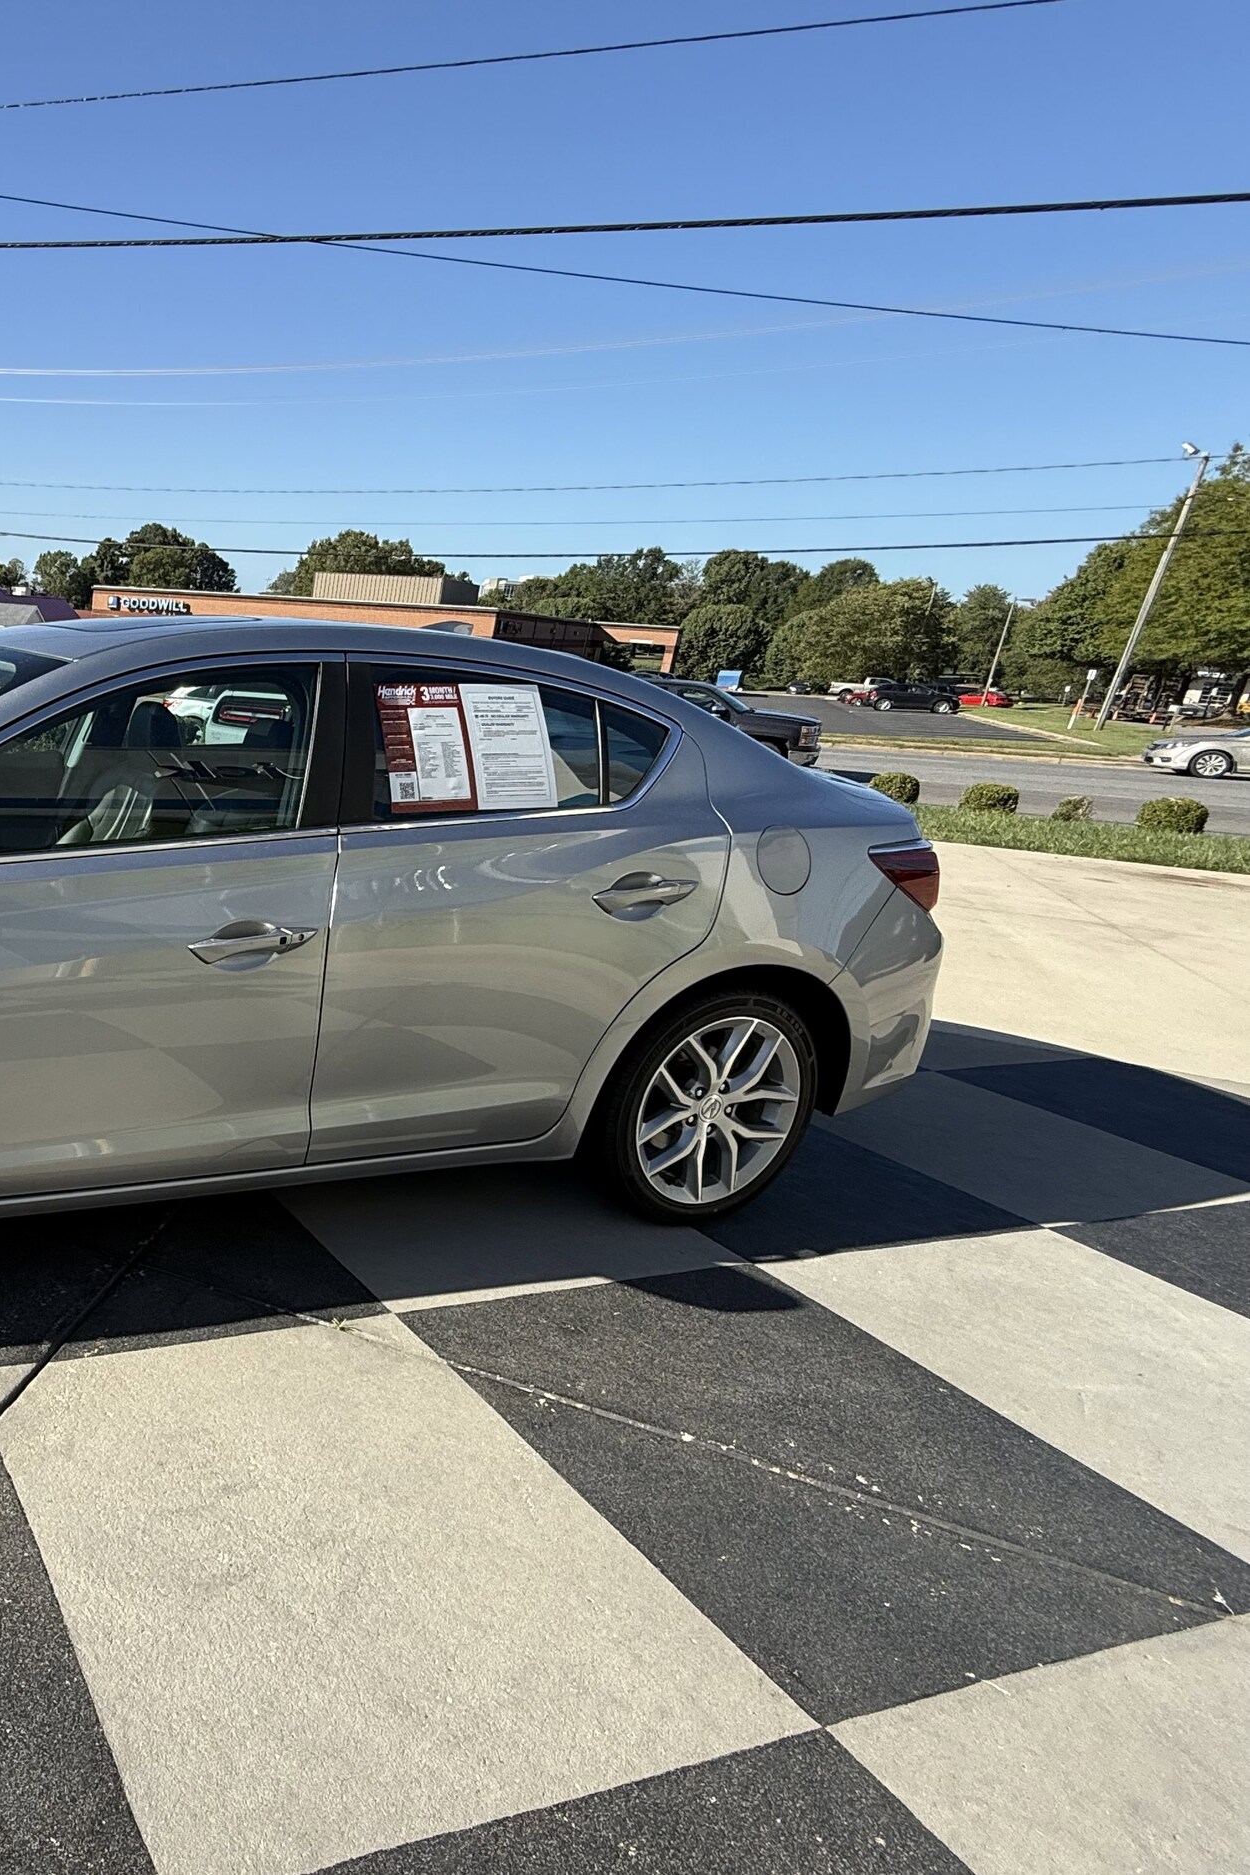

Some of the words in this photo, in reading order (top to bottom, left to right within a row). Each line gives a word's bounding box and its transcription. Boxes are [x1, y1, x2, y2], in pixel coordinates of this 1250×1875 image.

[120, 597, 188, 613] GOODWILL
[377, 685, 417, 700] Hendrick
[420, 686, 430, 701] 3
